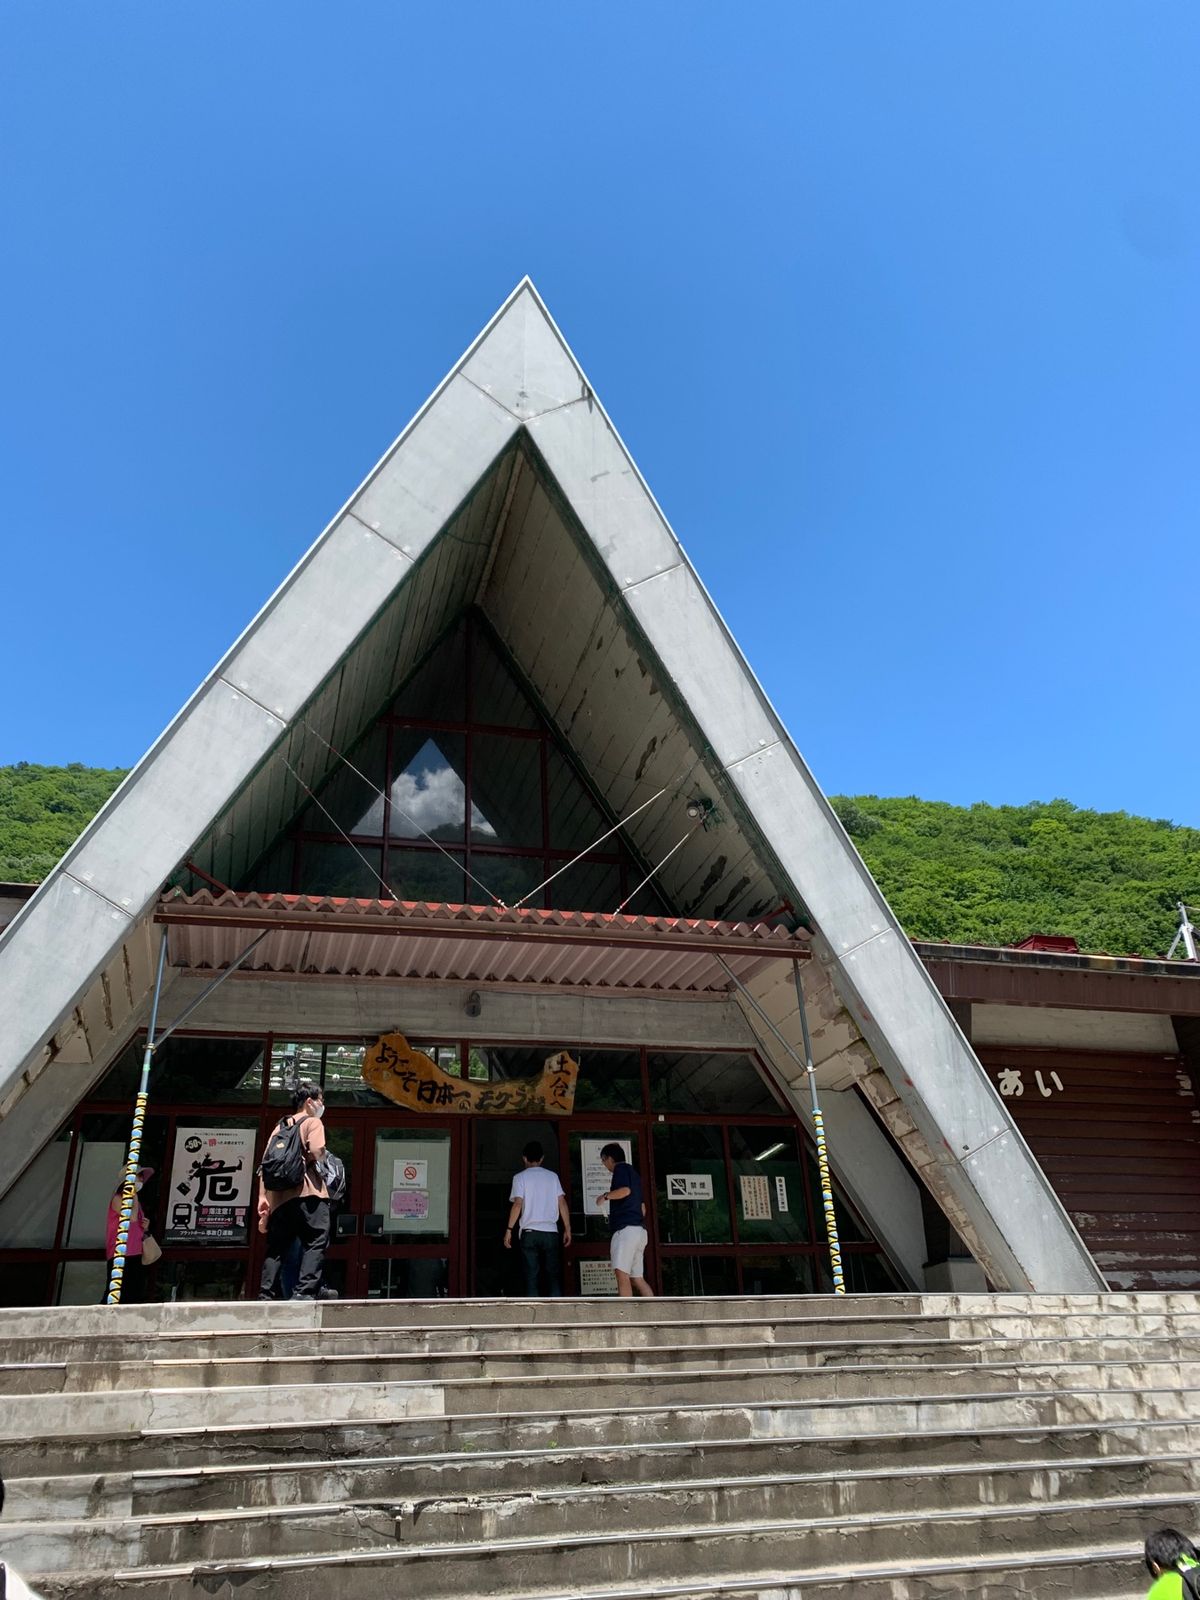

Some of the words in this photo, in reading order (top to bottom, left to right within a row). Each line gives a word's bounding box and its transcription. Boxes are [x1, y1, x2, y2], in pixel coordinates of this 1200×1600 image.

[375, 1044, 417, 1092] ようこそ
[550, 1055, 571, 1110] 土合へ
[998, 1068, 1063, 1097] あい
